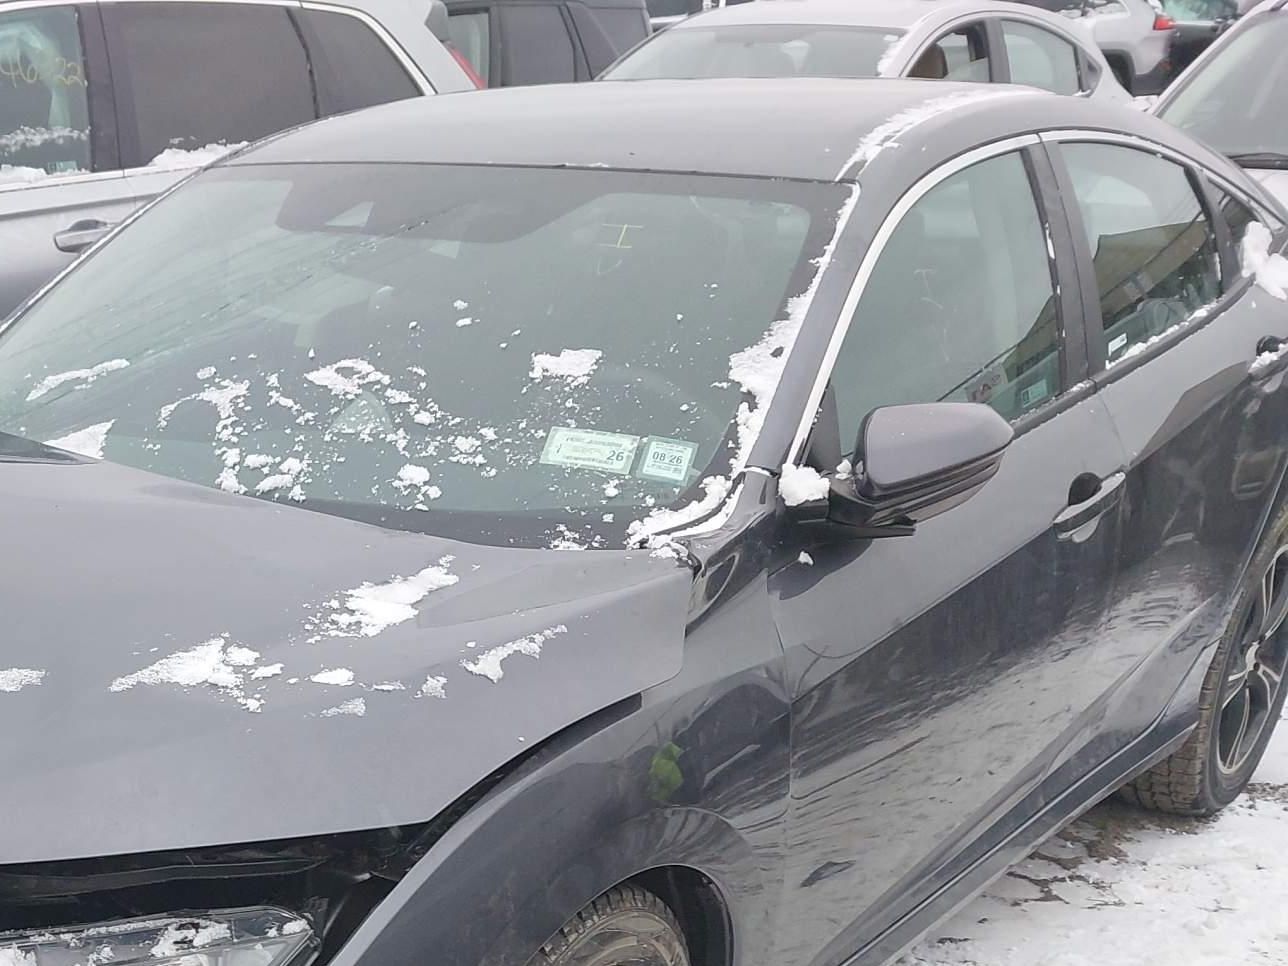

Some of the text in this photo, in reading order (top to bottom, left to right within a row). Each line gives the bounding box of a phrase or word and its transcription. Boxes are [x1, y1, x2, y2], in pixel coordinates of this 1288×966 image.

[606, 449, 625, 462] 26
[652, 451, 684, 465] 08 26
